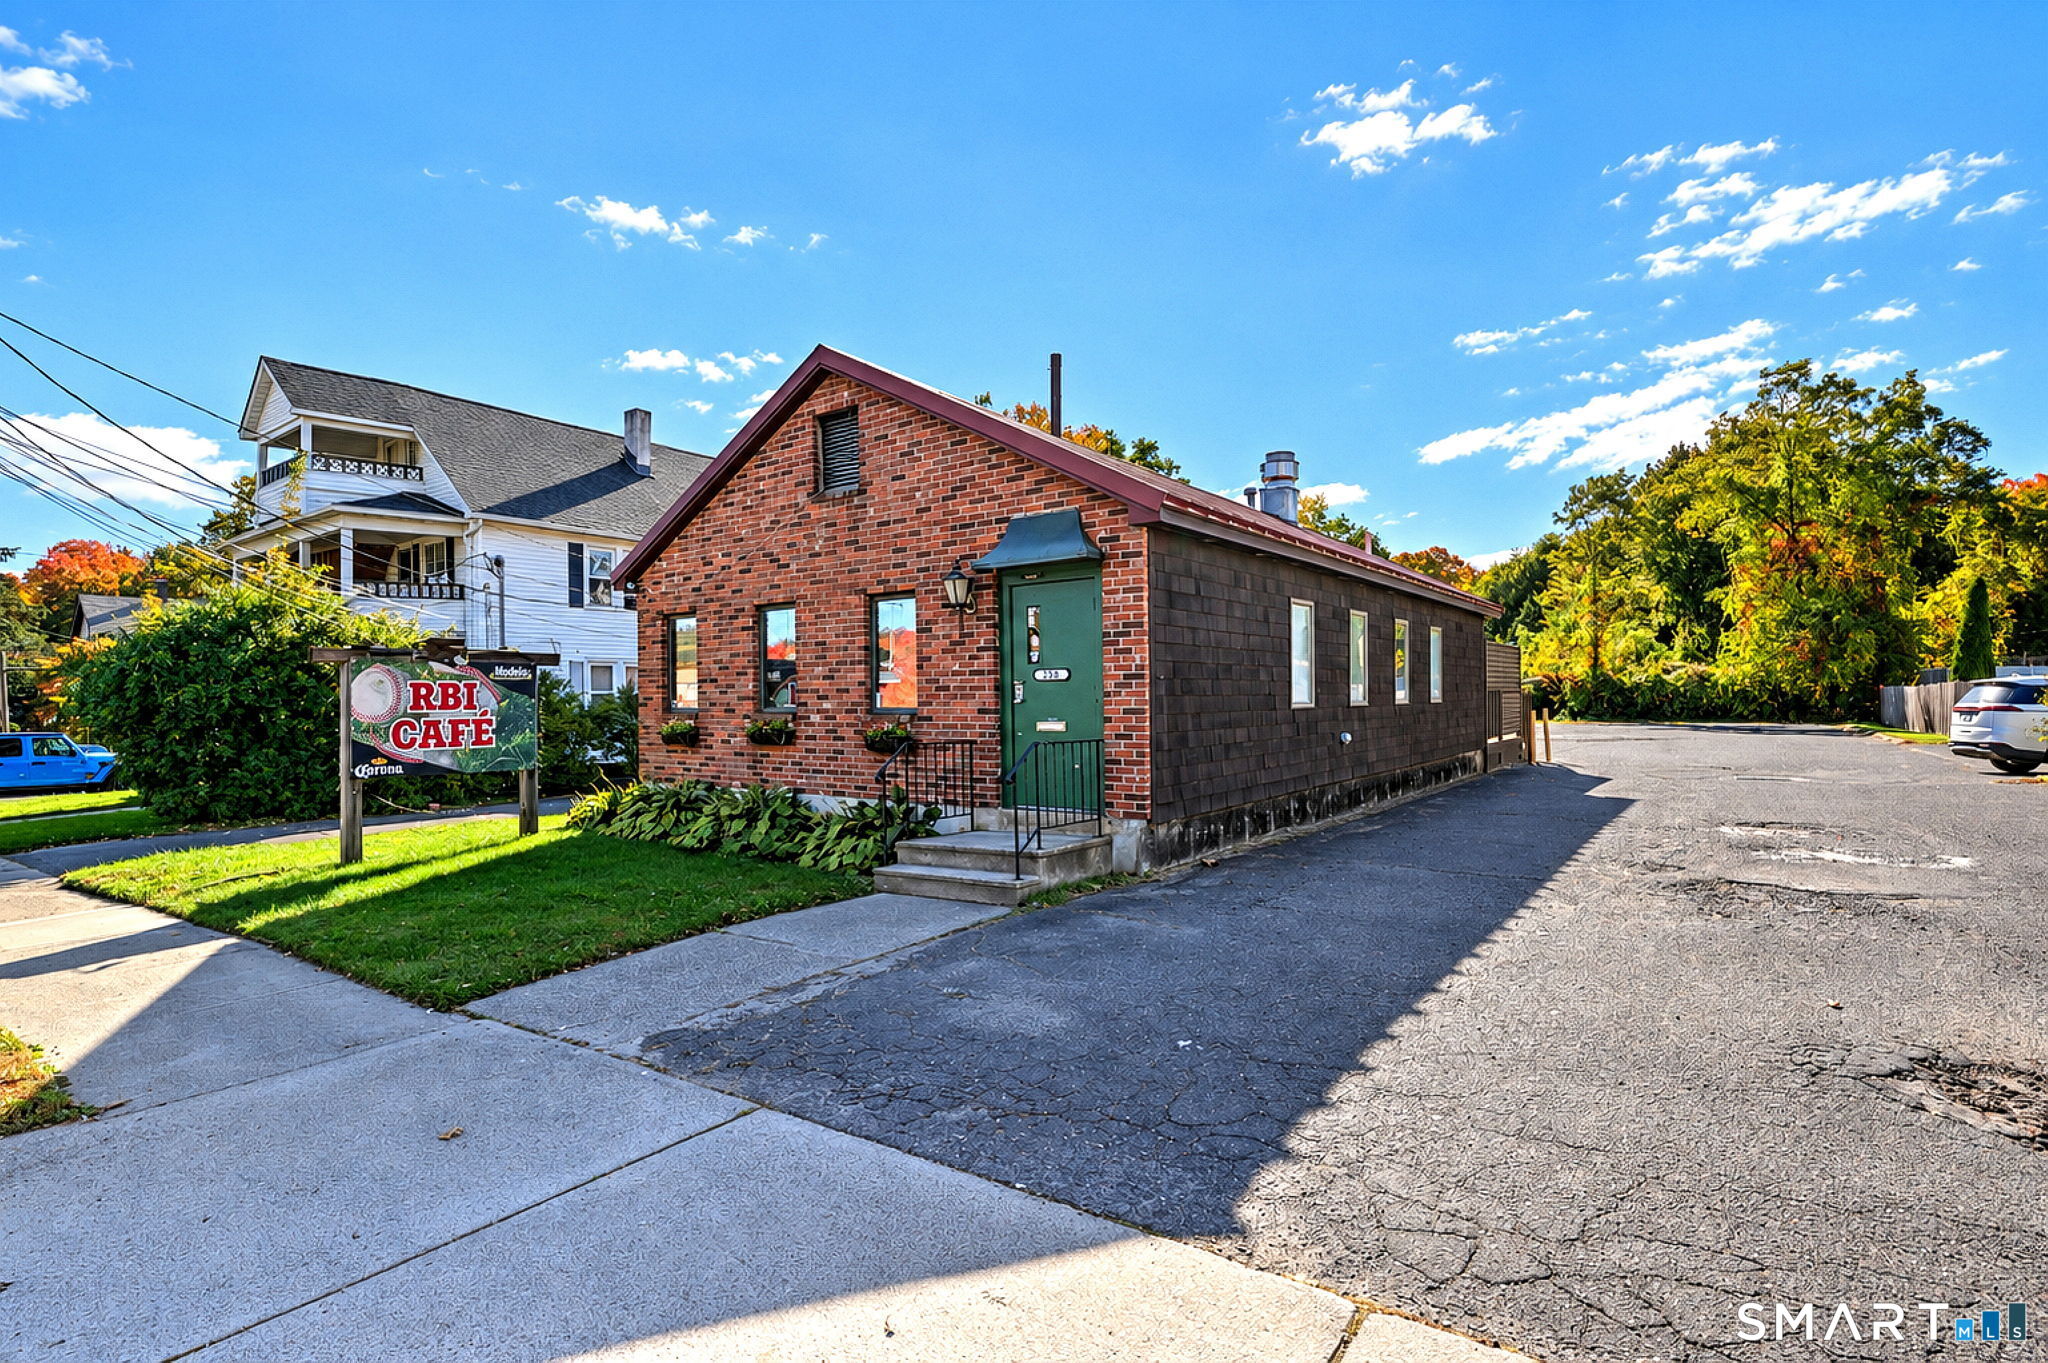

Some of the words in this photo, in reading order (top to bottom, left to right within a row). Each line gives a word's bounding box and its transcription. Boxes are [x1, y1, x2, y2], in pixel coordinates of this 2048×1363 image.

[408, 681, 479, 712] RBI
[391, 709, 495, 750] CAFÉ
[354, 763, 404, 779] Corona
